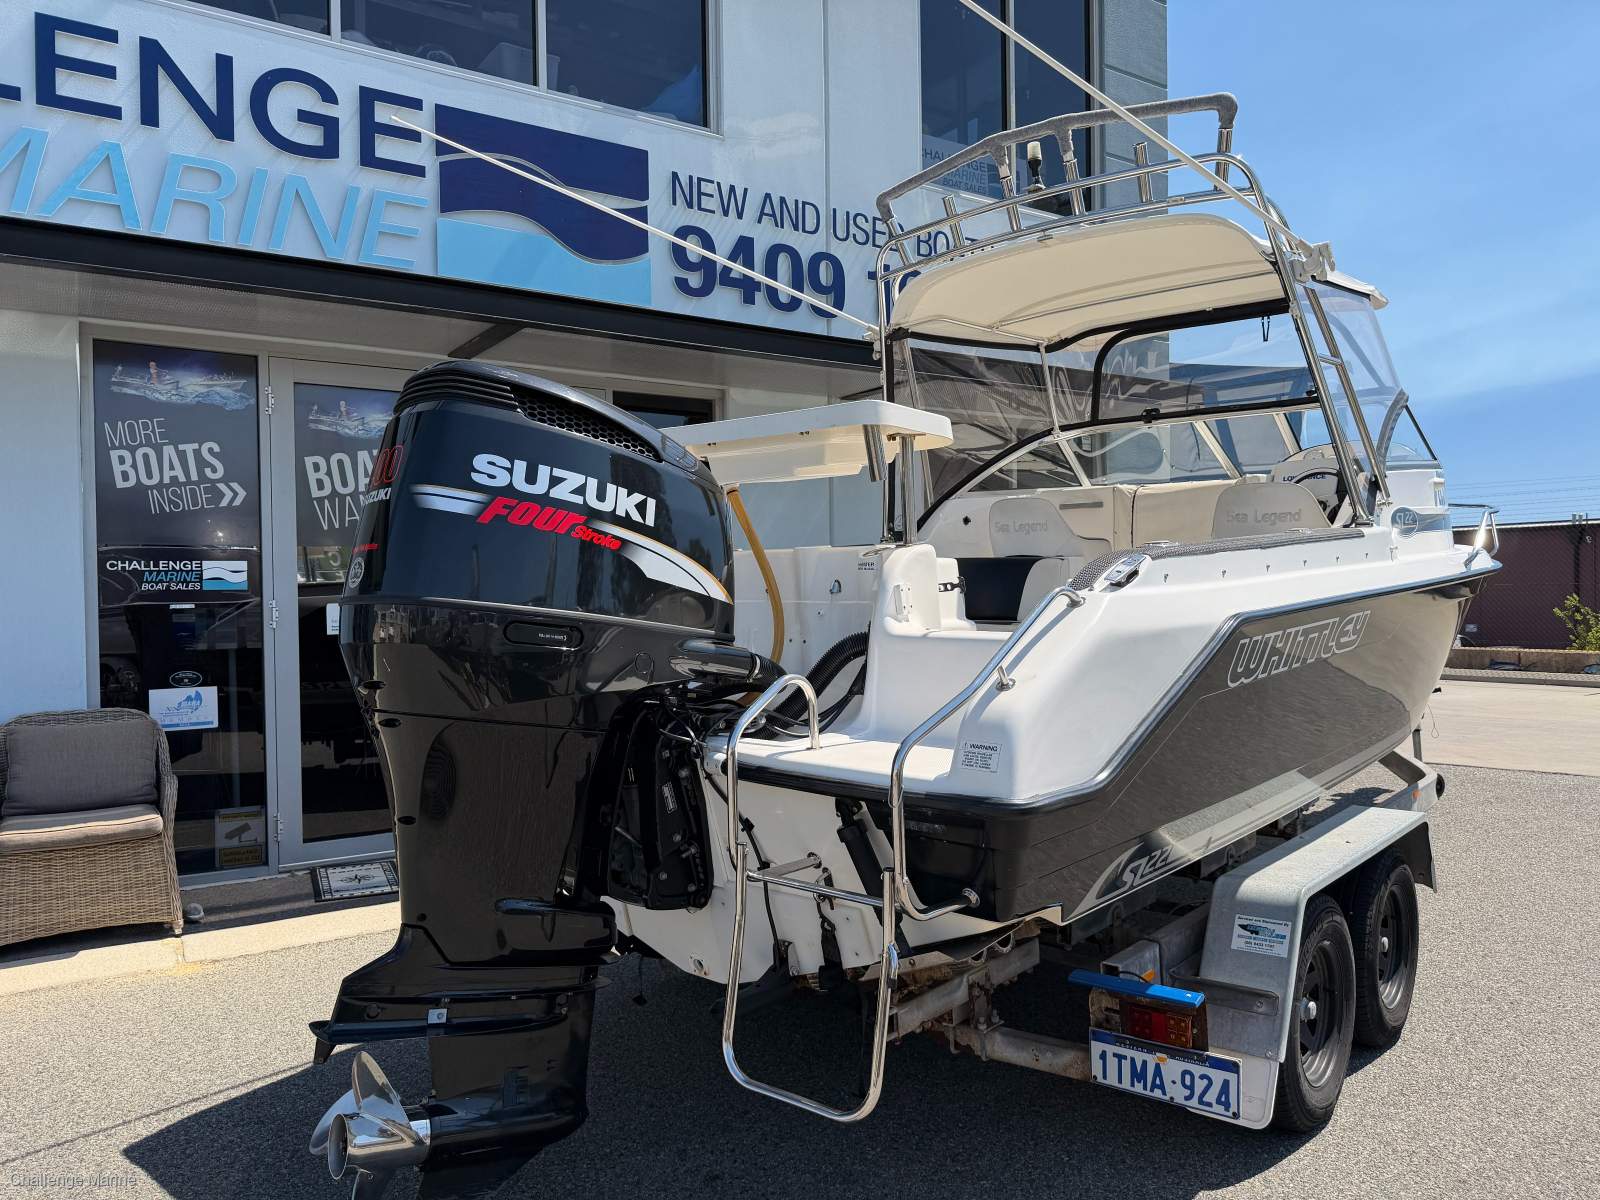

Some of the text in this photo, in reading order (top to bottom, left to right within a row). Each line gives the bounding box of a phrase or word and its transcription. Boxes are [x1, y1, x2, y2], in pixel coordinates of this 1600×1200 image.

[0, 12, 427, 178] ENGE
[671, 172, 748, 220] NEW
[757, 192, 820, 235] AND
[671, 224, 846, 319] 9409
[104, 418, 169, 448] MORE
[109, 441, 225, 489] BOATS
[304, 448, 379, 498] BOA
[148, 483, 216, 515] INSIDE
[470, 453, 657, 528] SUZUKI
[994, 520, 1048, 536] Sea Legend
[1226, 508, 1302, 527] Sea Legend
[570, 525, 622, 551] Stroke
[106, 560, 201, 571] CHALLENGE
[143, 571, 201, 582] MARINE
[141, 582, 201, 591] BOAT SALES
[1227, 609, 1371, 688] WHITTLEY
[969, 743, 998, 752] WARNING
